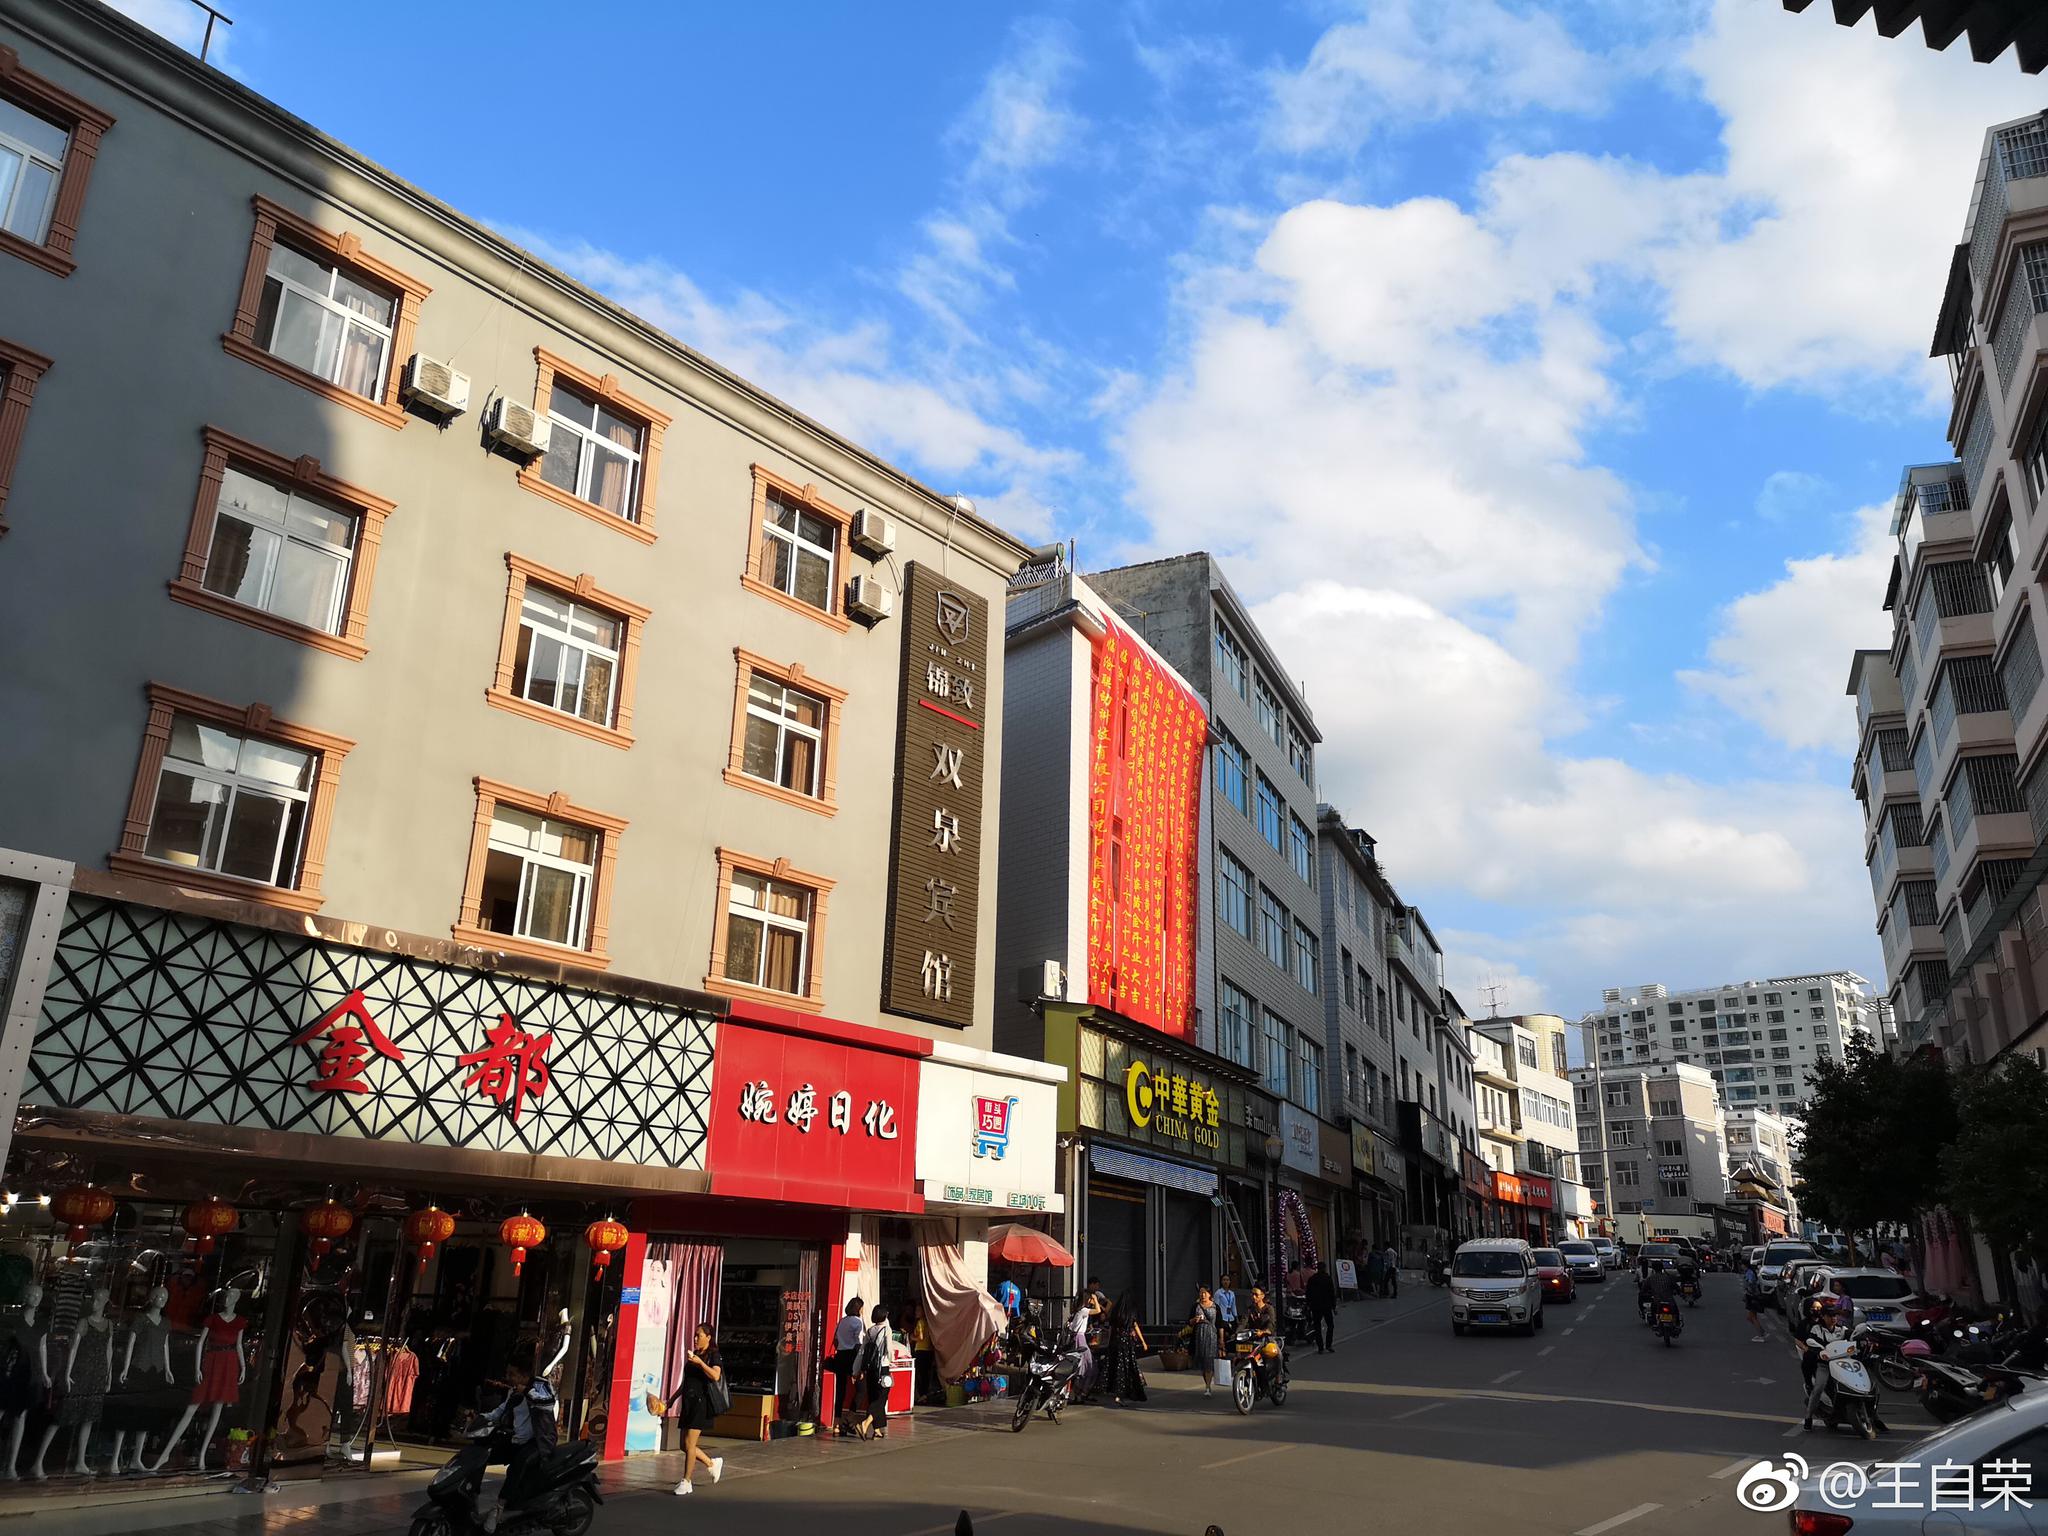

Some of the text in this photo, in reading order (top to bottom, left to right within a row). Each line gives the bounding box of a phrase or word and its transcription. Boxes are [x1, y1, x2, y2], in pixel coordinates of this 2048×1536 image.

[925, 660, 974, 710] 锦致
[921, 743, 964, 1003] 双泉宾馆
[293, 988, 554, 1124] 金都
[738, 1080, 898, 1139] 婉婷日化
[984, 1101, 1002, 1115] 街头
[1156, 1114, 1220, 1149] CHINA GOLD
[1008, 1191, 1047, 1210] 全场10元
